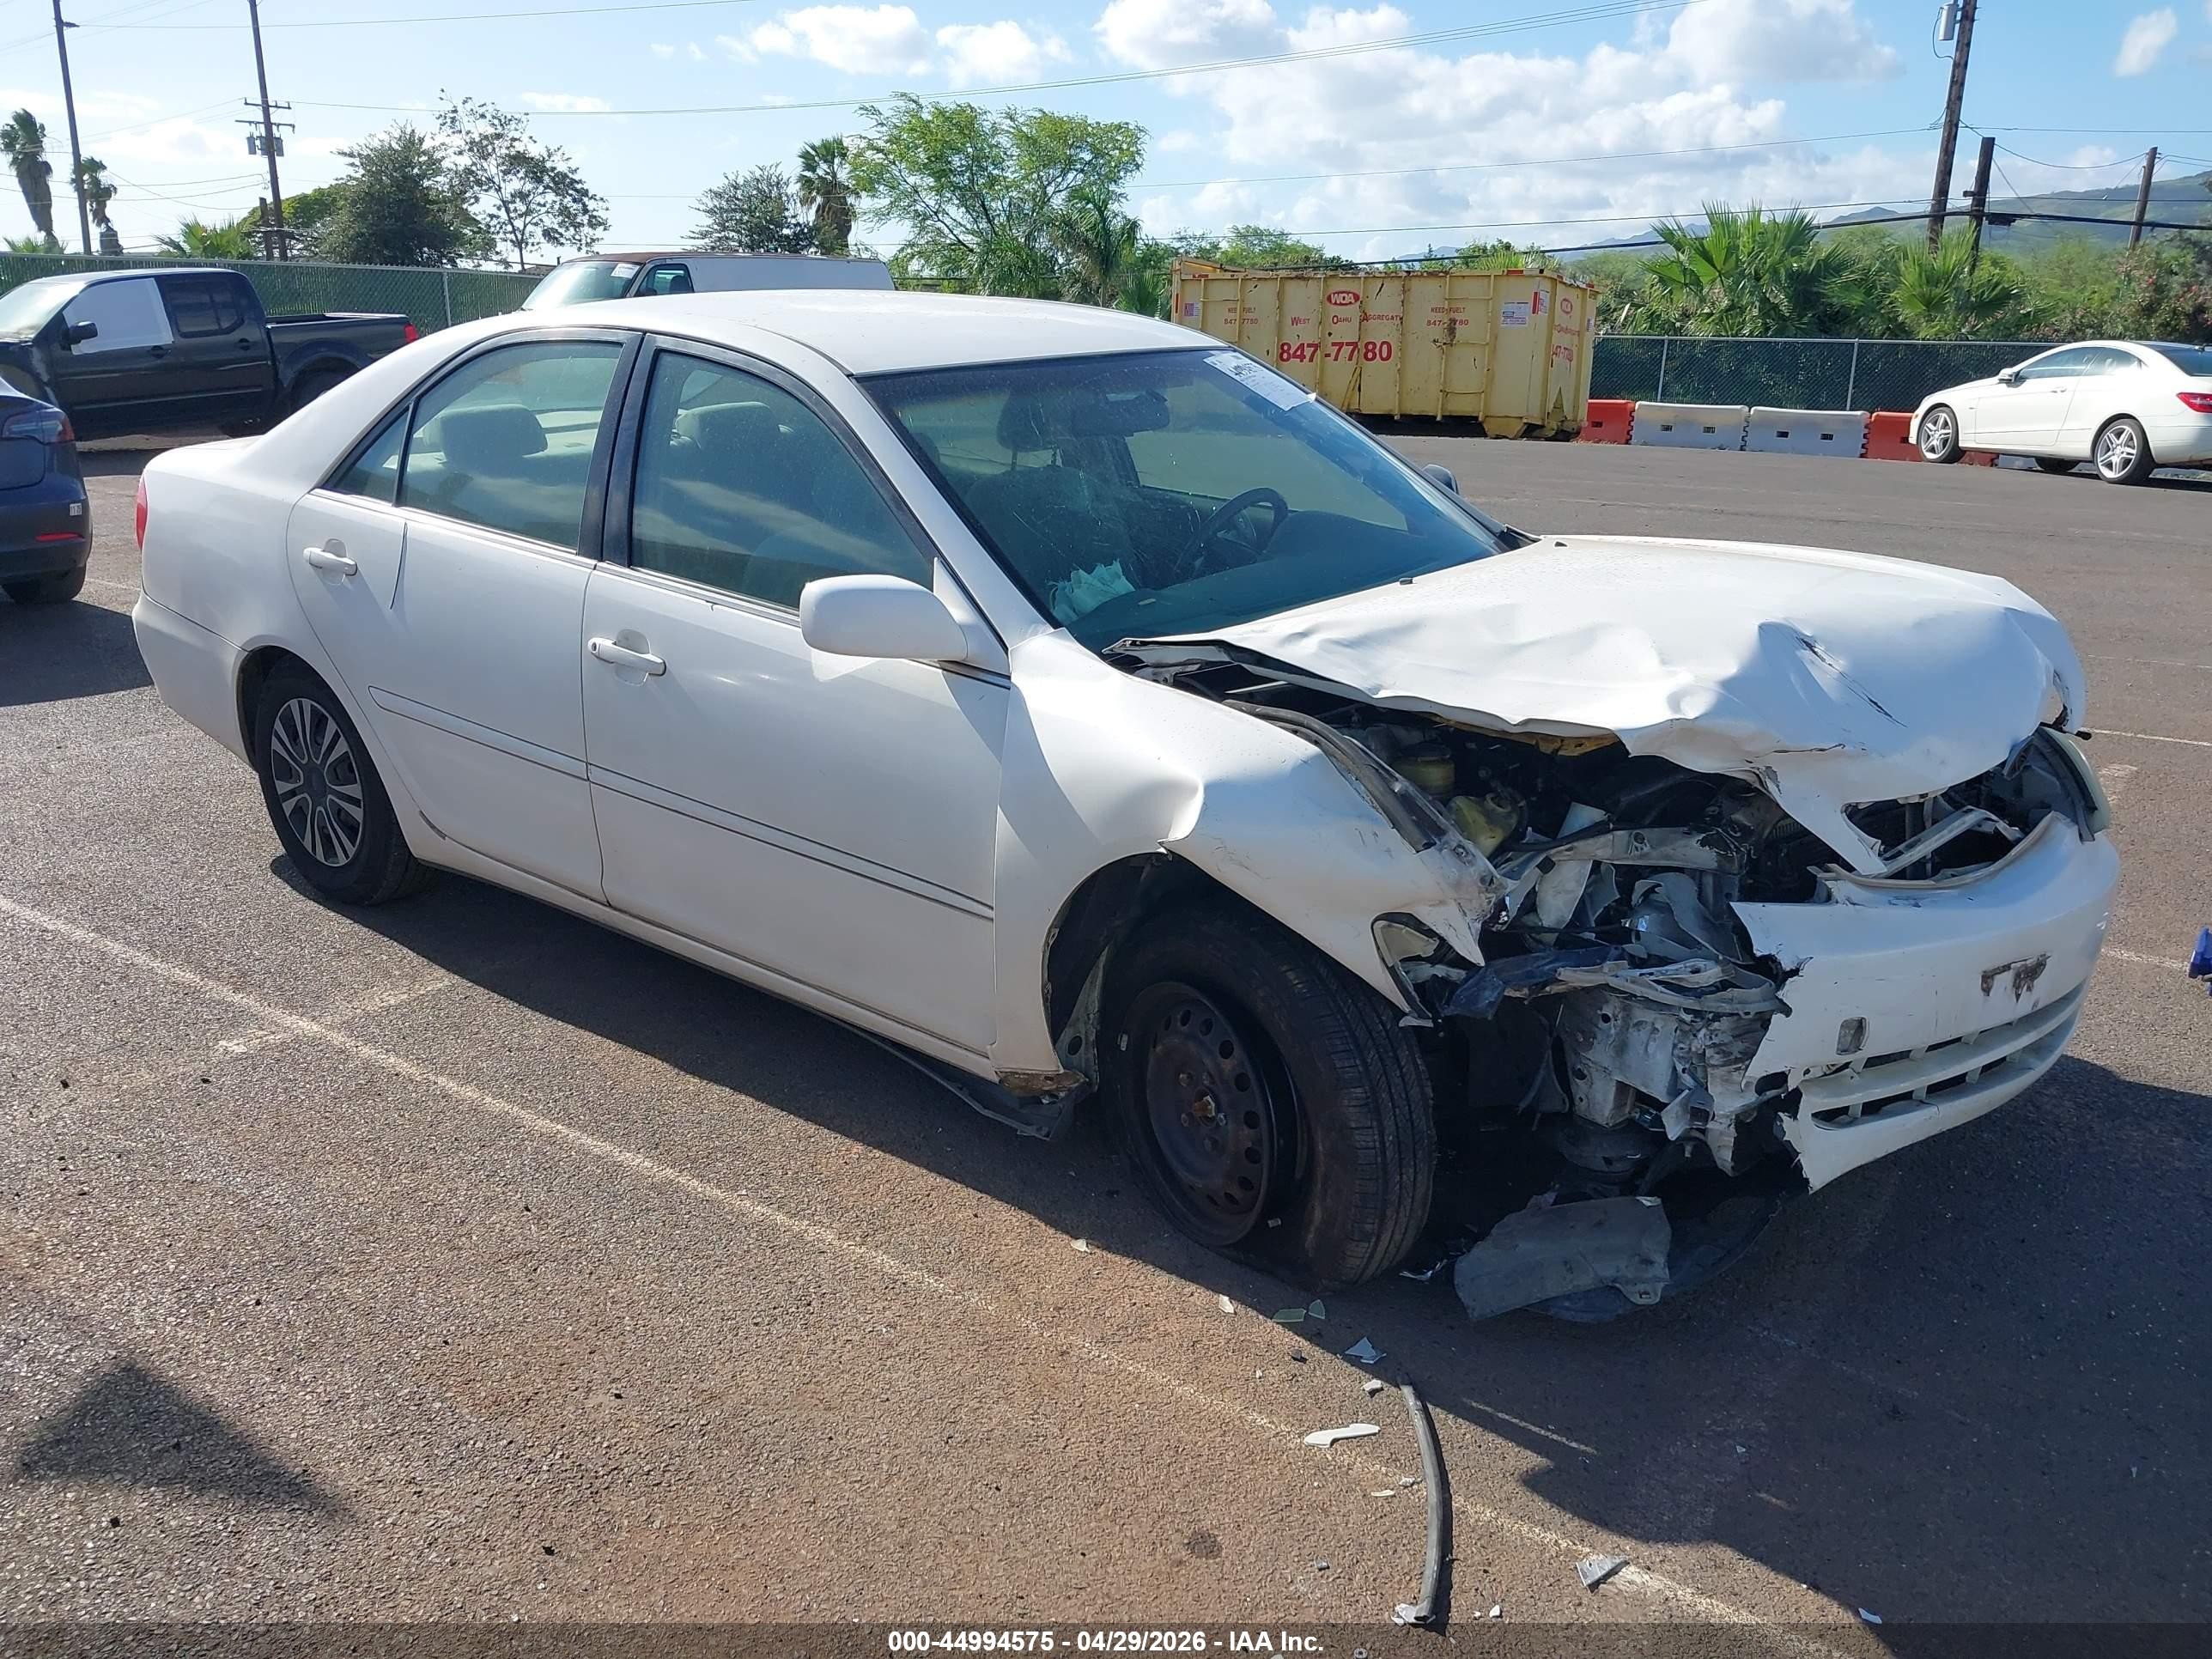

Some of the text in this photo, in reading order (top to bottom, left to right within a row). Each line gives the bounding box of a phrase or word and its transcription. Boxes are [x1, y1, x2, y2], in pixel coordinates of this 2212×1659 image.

[1330, 293, 1355, 304] WOA
[1291, 316, 1310, 326] WEST
[1331, 314, 1352, 325] OAHU
[1279, 340, 1393, 362] 847-7780
